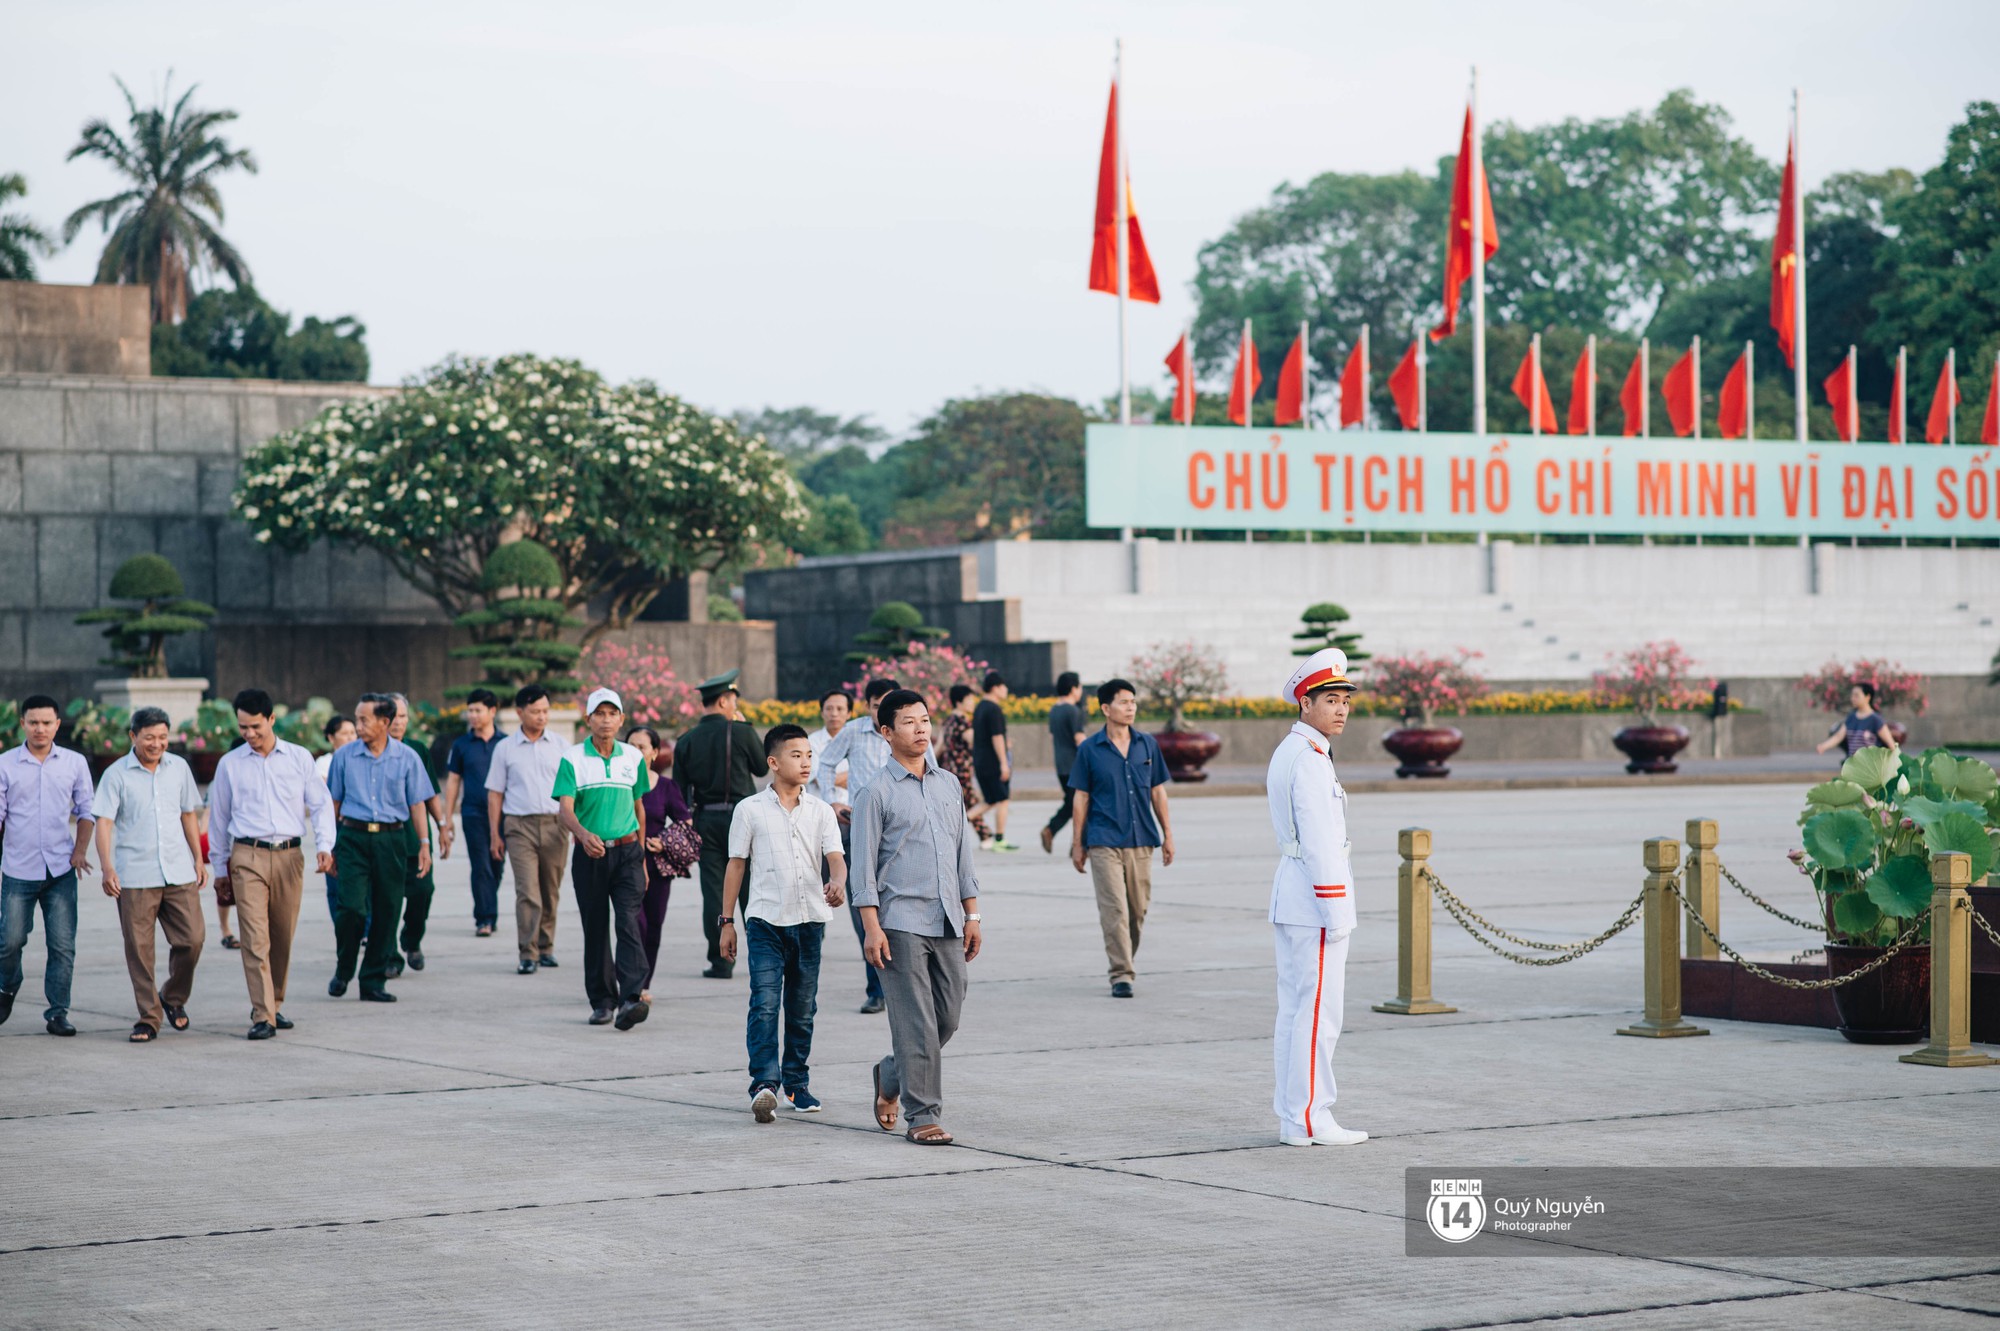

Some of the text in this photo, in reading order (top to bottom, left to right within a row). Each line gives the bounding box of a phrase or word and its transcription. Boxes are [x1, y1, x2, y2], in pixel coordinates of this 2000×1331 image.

[1188, 433, 2000, 531] CHỦ TỊCH HỒ CHÍ MINH VĨ ĐẠI SỐ
